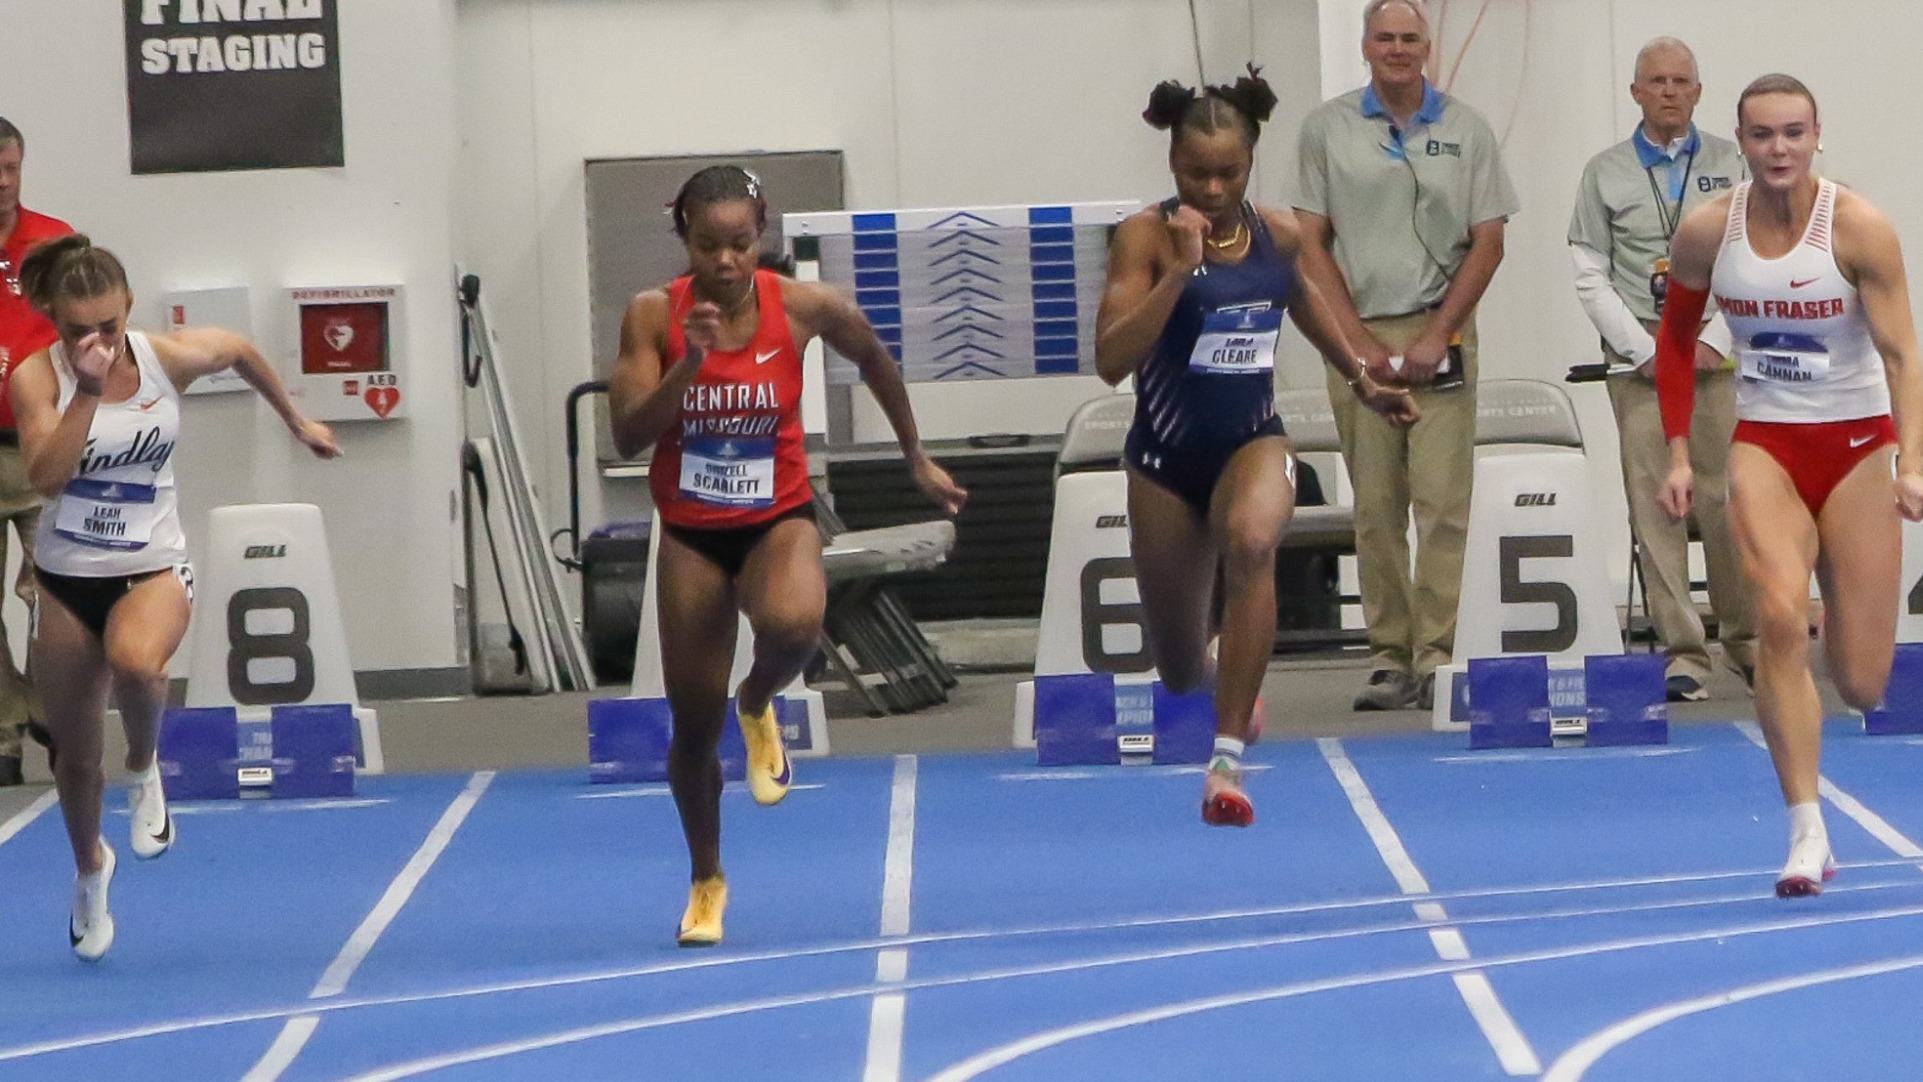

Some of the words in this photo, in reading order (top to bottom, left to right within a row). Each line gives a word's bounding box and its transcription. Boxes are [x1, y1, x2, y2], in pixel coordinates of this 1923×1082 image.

[141, 0, 323, 25] FINAL
[141, 33, 326, 74] STAGING
[1763, 297, 1845, 320] FRASER
[1757, 361, 1812, 381] CANNAN
[683, 382, 779, 411] CENTRAL
[682, 415, 779, 437] MISSOURI
[80, 426, 175, 475] indlay
[693, 473, 760, 494] SCARLETT
[1514, 492, 1557, 508] GILL
[93, 506, 121, 519] LEAH
[1095, 514, 1128, 529] GIL
[83, 518, 126, 536] SMITH
[244, 544, 287, 560] GILL
[1499, 535, 1578, 653] 5
[1080, 556, 1157, 673] 6
[227, 586, 315, 705] 8
